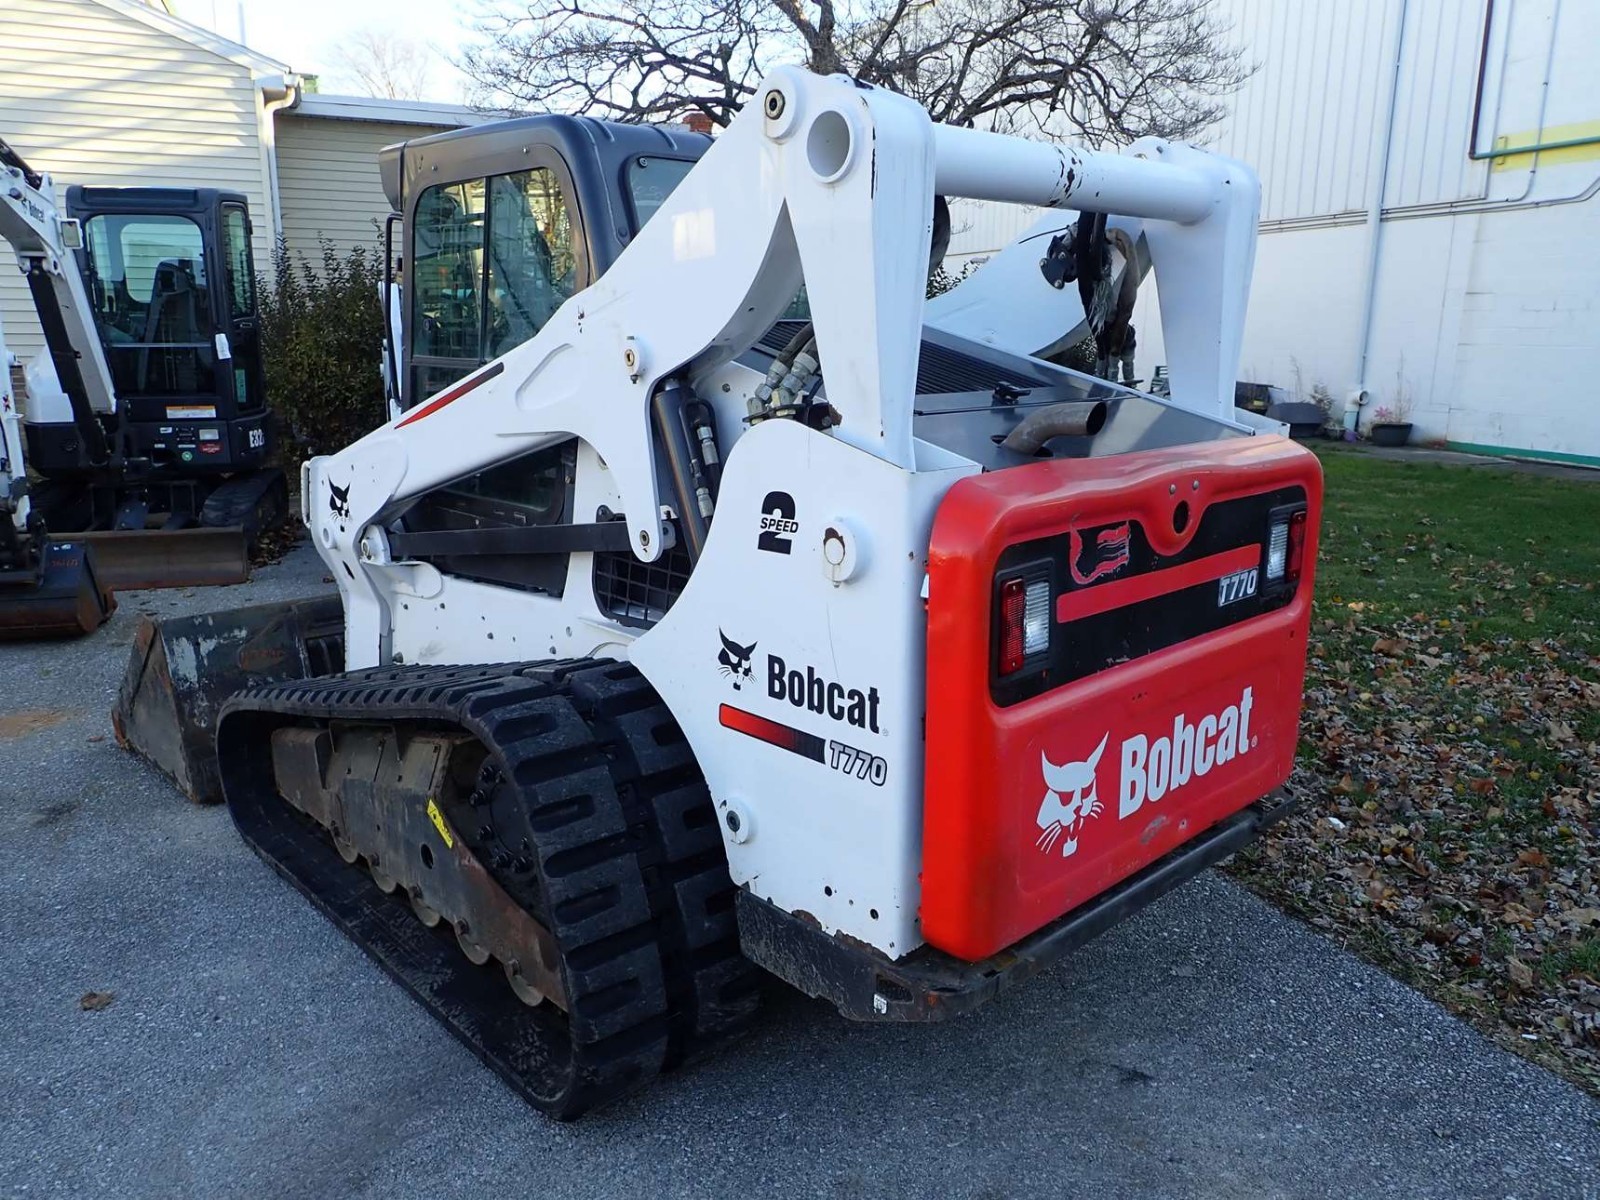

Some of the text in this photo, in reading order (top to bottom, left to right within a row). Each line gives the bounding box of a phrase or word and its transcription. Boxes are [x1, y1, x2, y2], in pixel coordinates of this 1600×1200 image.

[760, 517, 799, 534] SPEED
[1221, 569, 1257, 604] T770
[768, 653, 880, 734] Bobcat
[829, 739, 887, 787] T770
[1119, 685, 1253, 820] Bobcat
